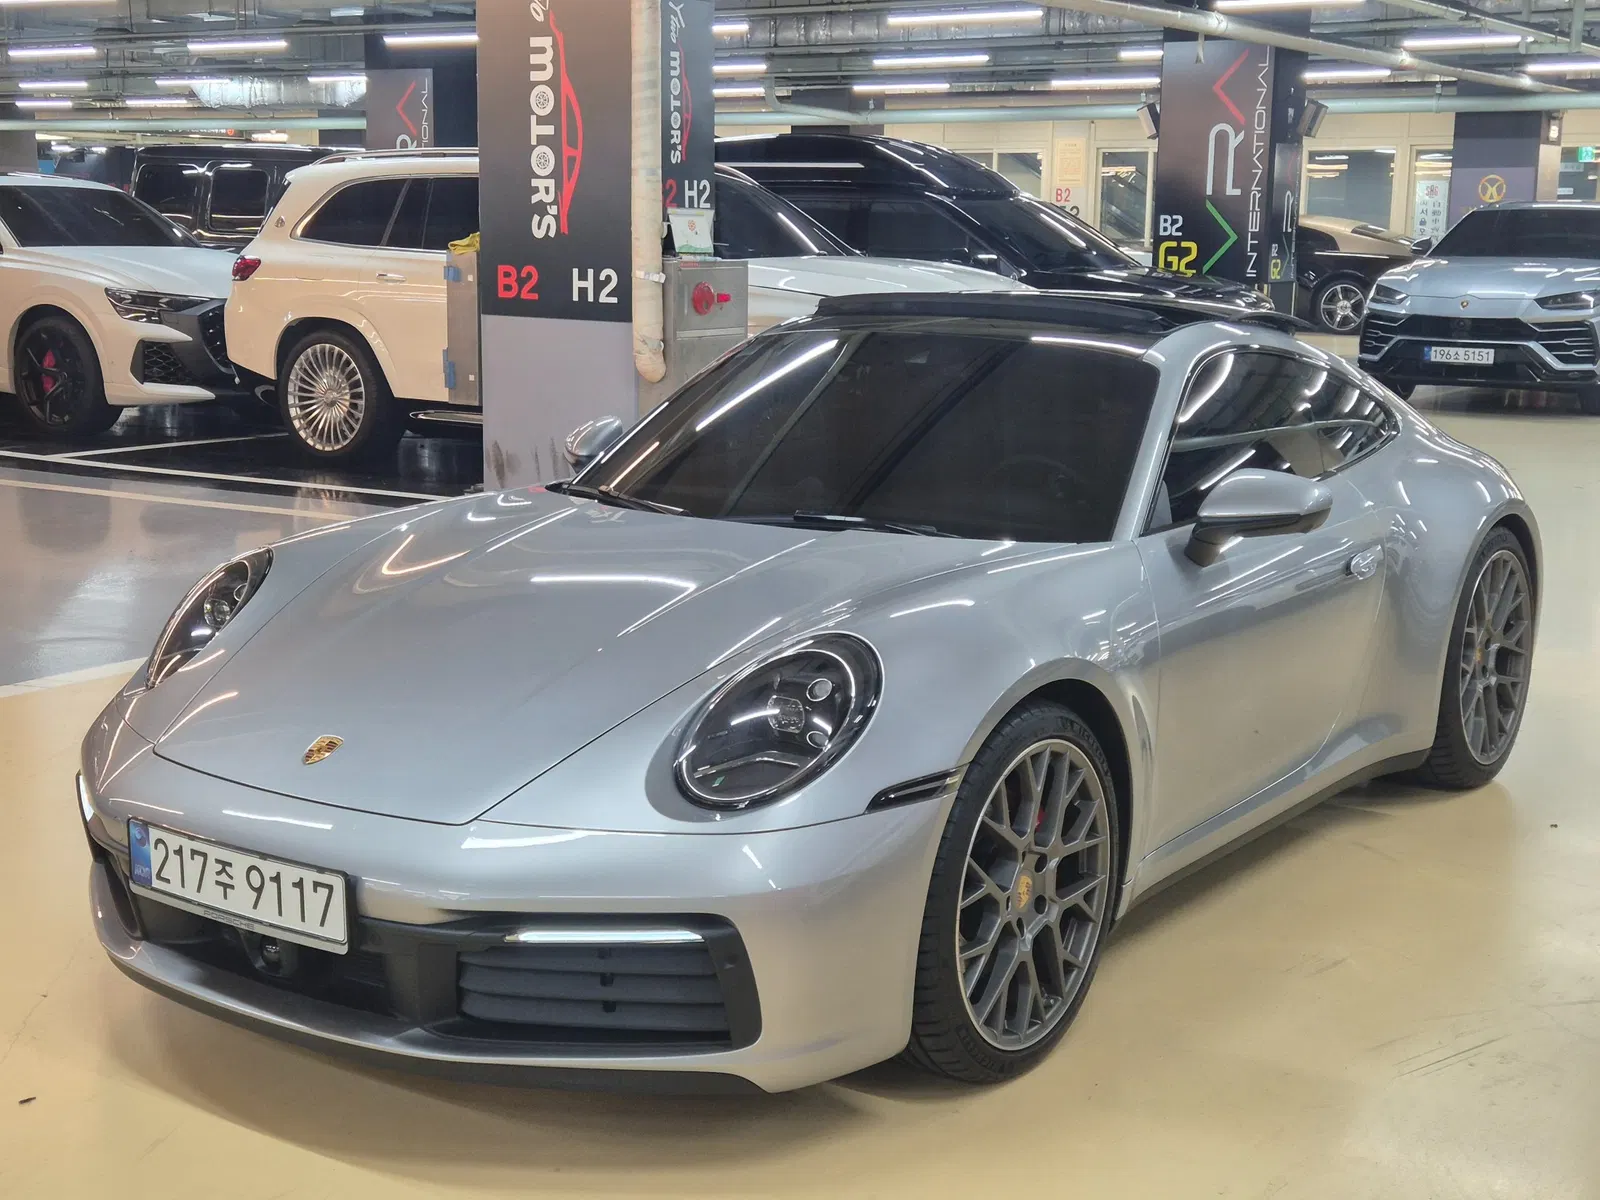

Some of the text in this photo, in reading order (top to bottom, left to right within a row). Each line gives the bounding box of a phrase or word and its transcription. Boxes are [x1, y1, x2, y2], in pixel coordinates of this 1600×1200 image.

[1246, 45, 1270, 277] INTERNATIONAL
[684, 179, 711, 208] H2
[1056, 187, 1071, 202] B2
[1159, 214, 1183, 236] B2
[1158, 241, 1198, 274] G2
[497, 265, 618, 303] B2 H2
